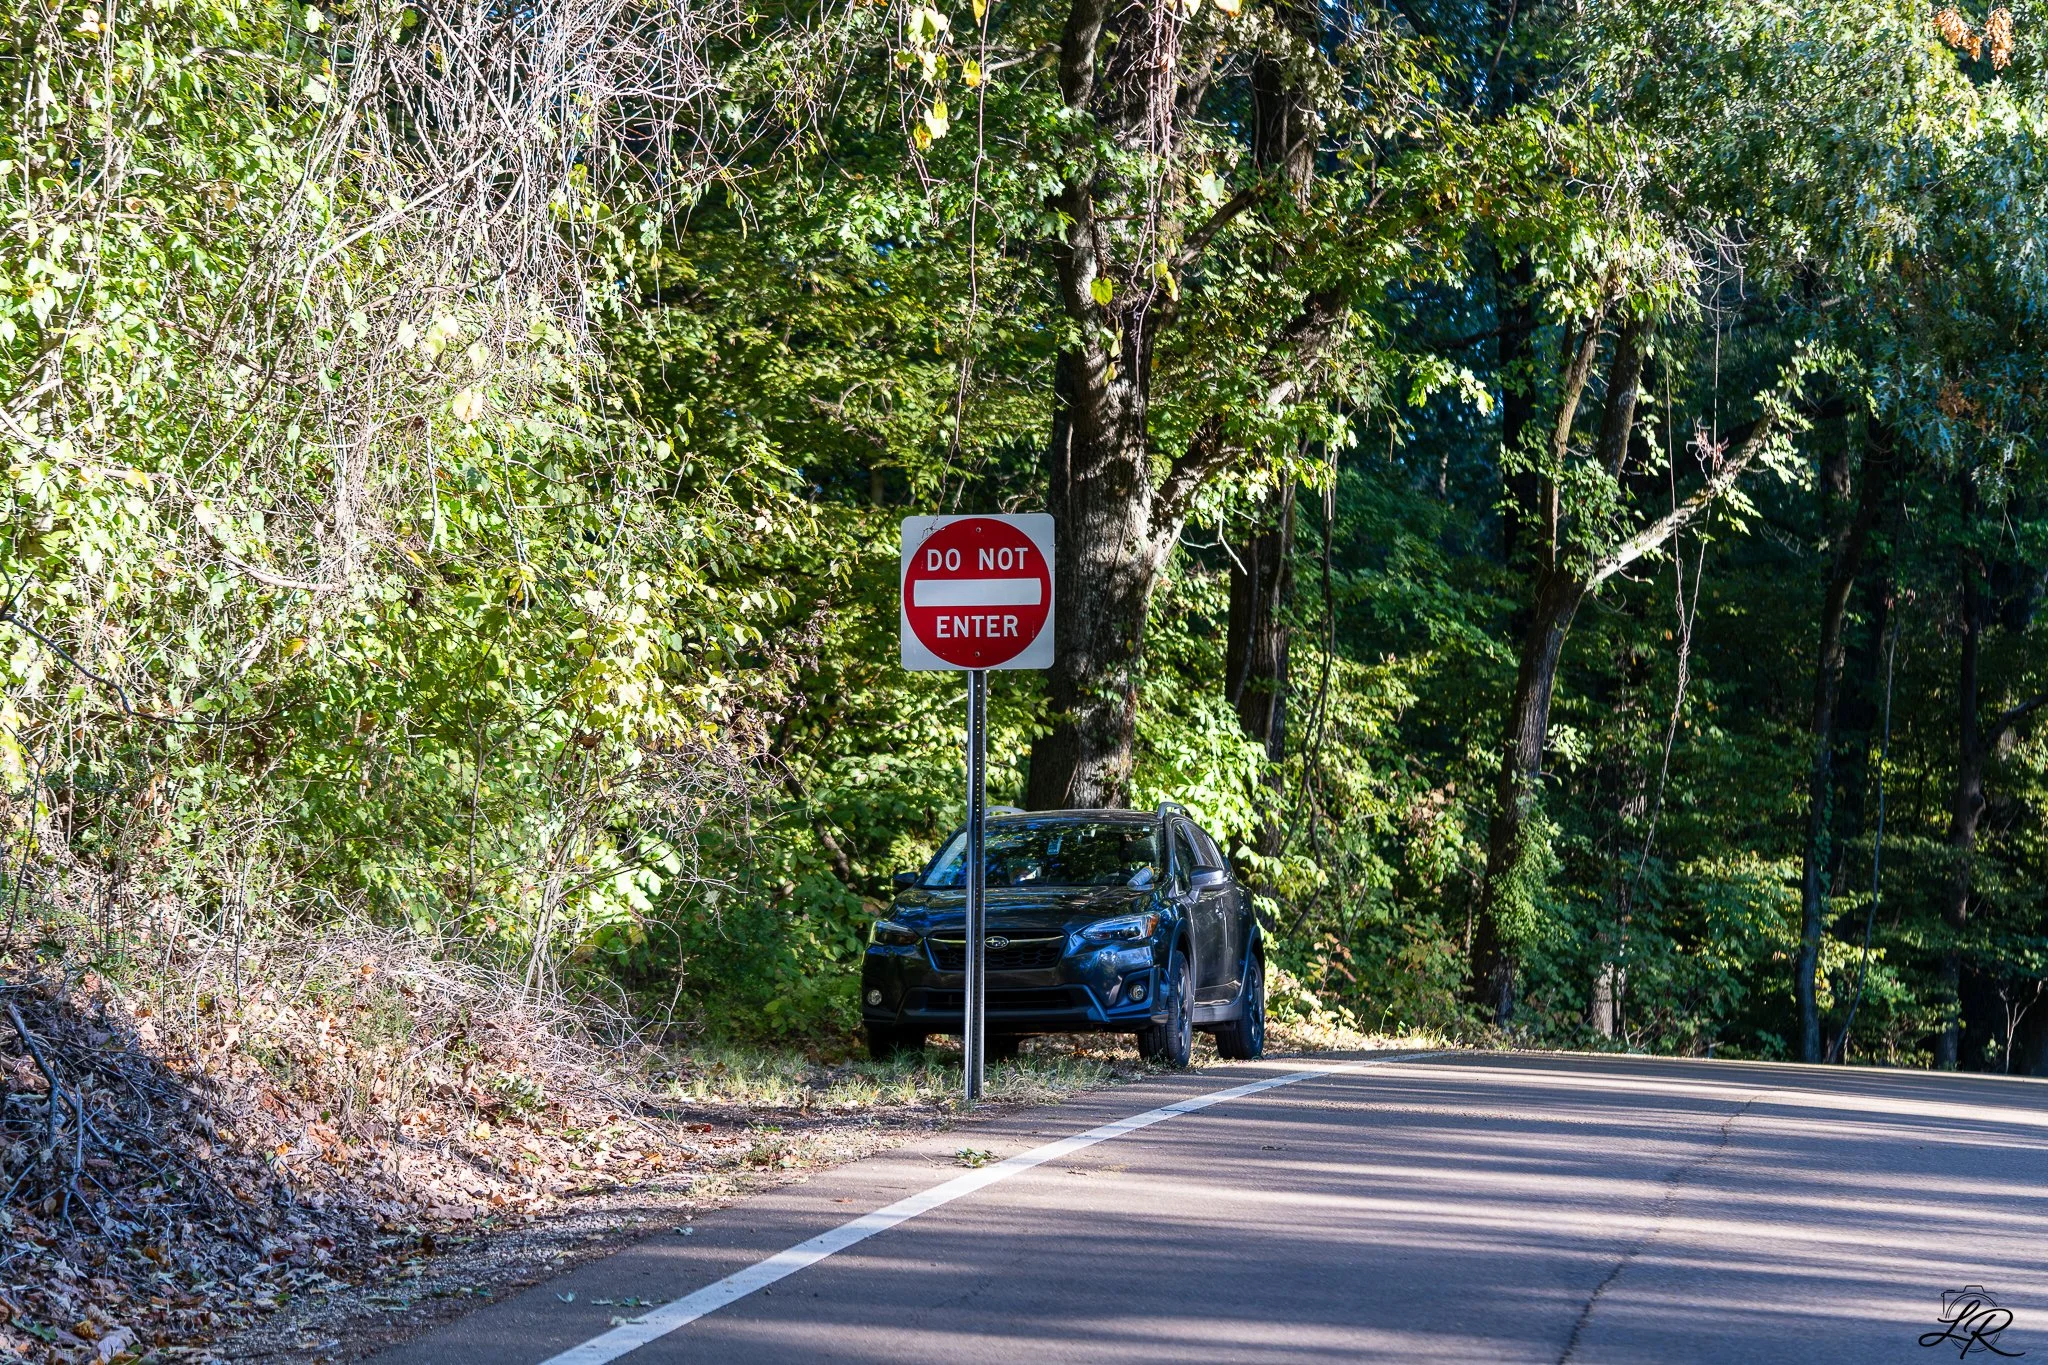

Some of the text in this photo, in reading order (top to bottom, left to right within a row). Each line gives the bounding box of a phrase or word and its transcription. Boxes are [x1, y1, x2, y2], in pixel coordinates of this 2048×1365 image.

[927, 547, 1029, 571] DO NOT
[936, 614, 1019, 638] ENTER
